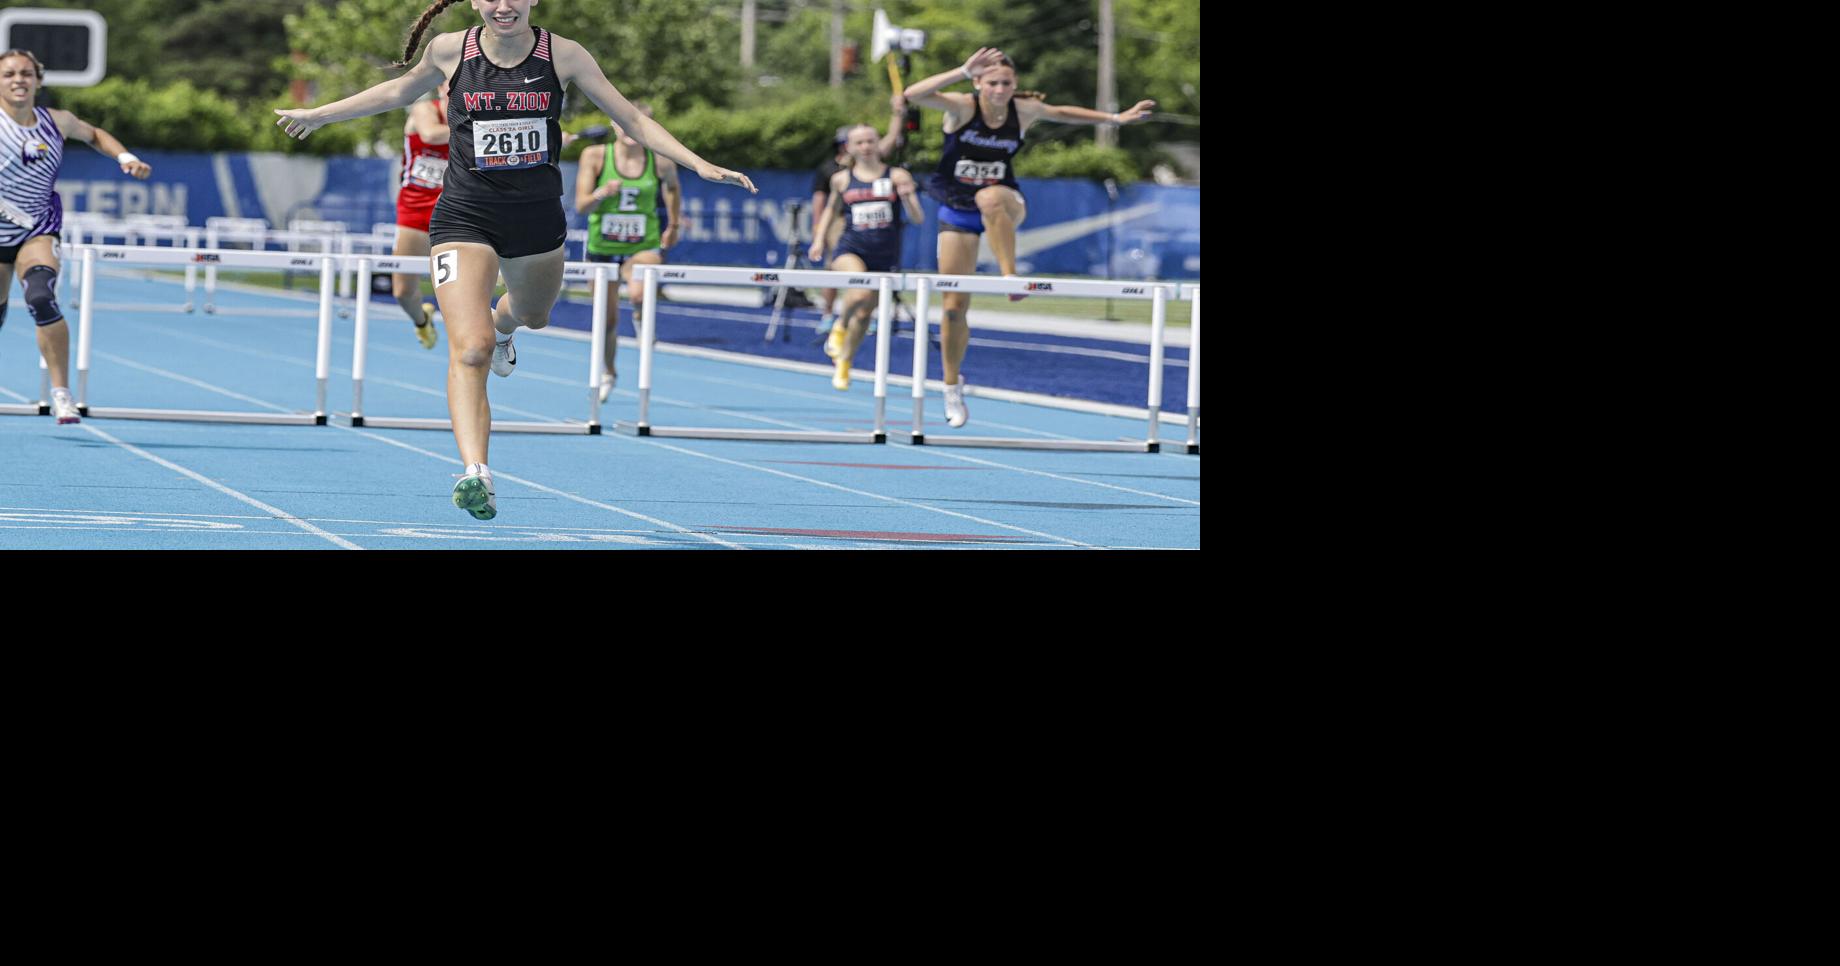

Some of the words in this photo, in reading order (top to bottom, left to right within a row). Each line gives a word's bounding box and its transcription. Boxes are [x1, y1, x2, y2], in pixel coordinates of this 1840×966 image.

[463, 92, 501, 111] MT.
[507, 91, 552, 111] ZION
[482, 130, 540, 155] 2610
[484, 156, 507, 166] TRACK
[524, 152, 542, 163] FIELD
[619, 187, 640, 211] E
[437, 253, 451, 284] 5
